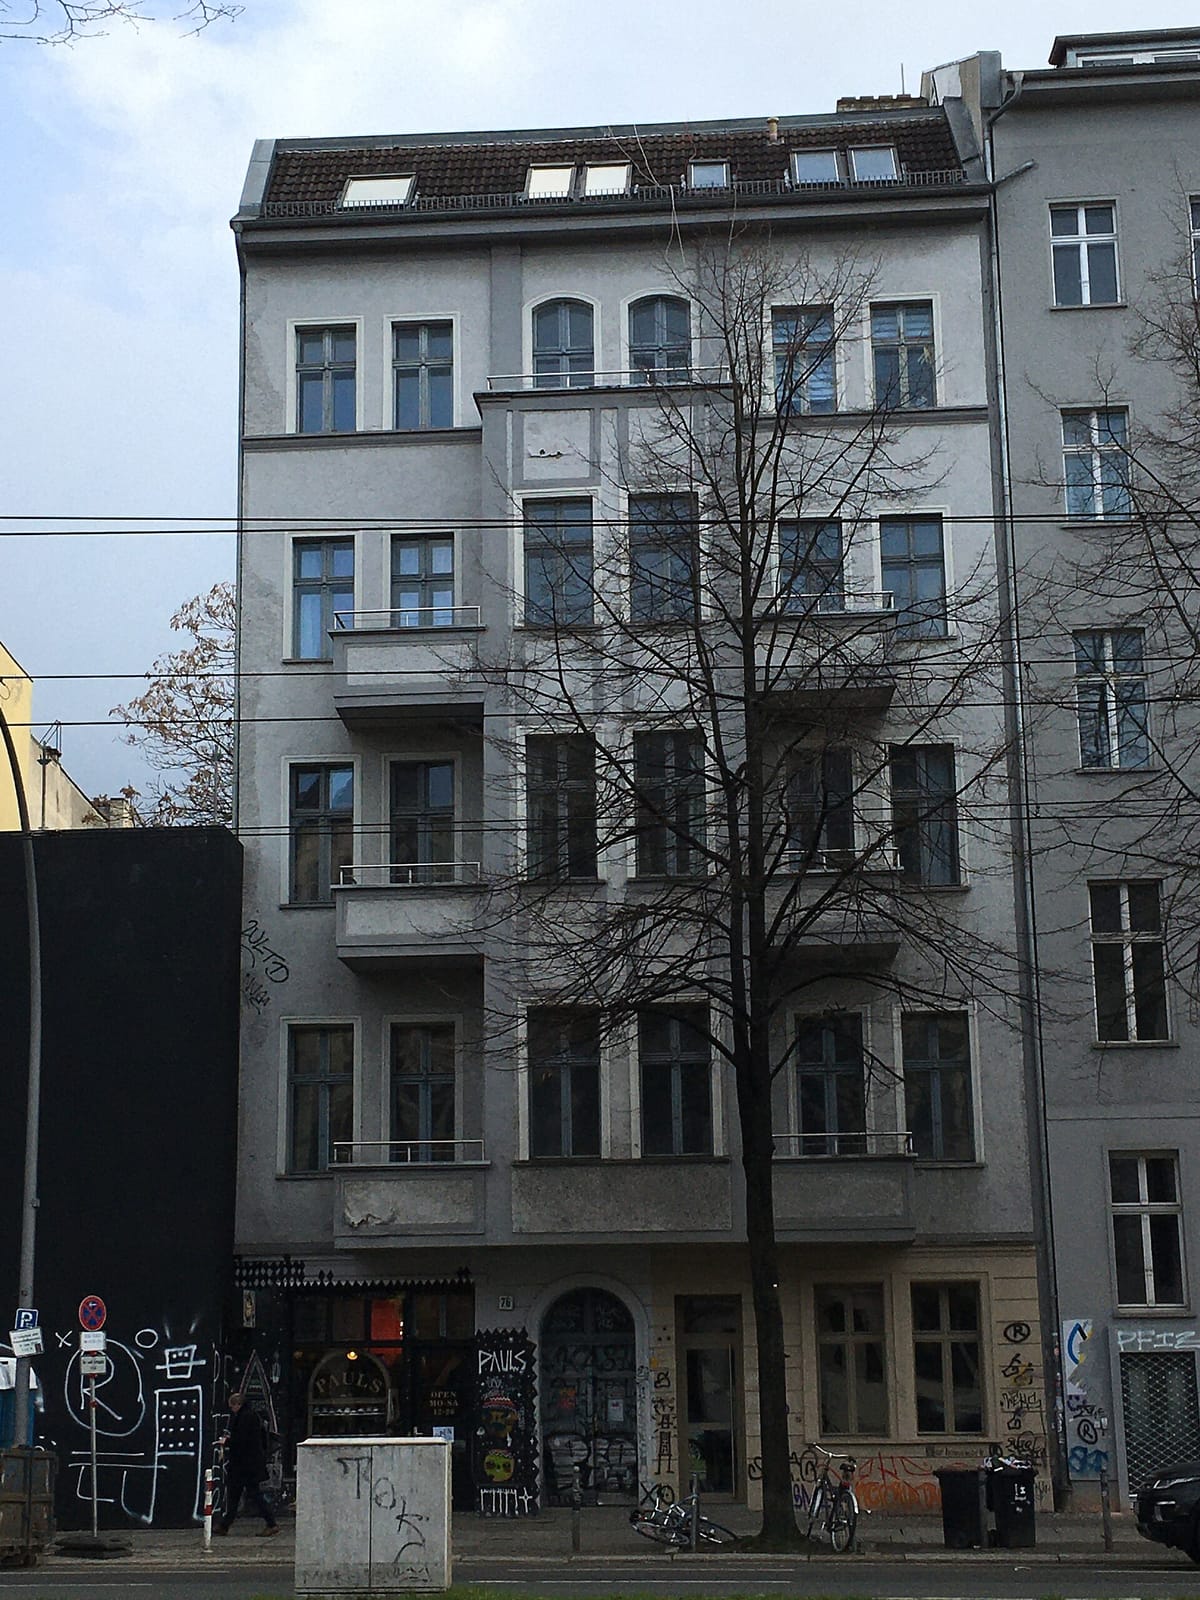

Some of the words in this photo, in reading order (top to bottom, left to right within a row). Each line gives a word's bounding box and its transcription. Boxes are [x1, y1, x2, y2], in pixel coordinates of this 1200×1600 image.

[500, 1297, 511, 1308] 76
[478, 1349, 527, 1375] PAULS
[315, 1371, 383, 1394] PAULS
[430, 1391, 457, 1399] OPEN
